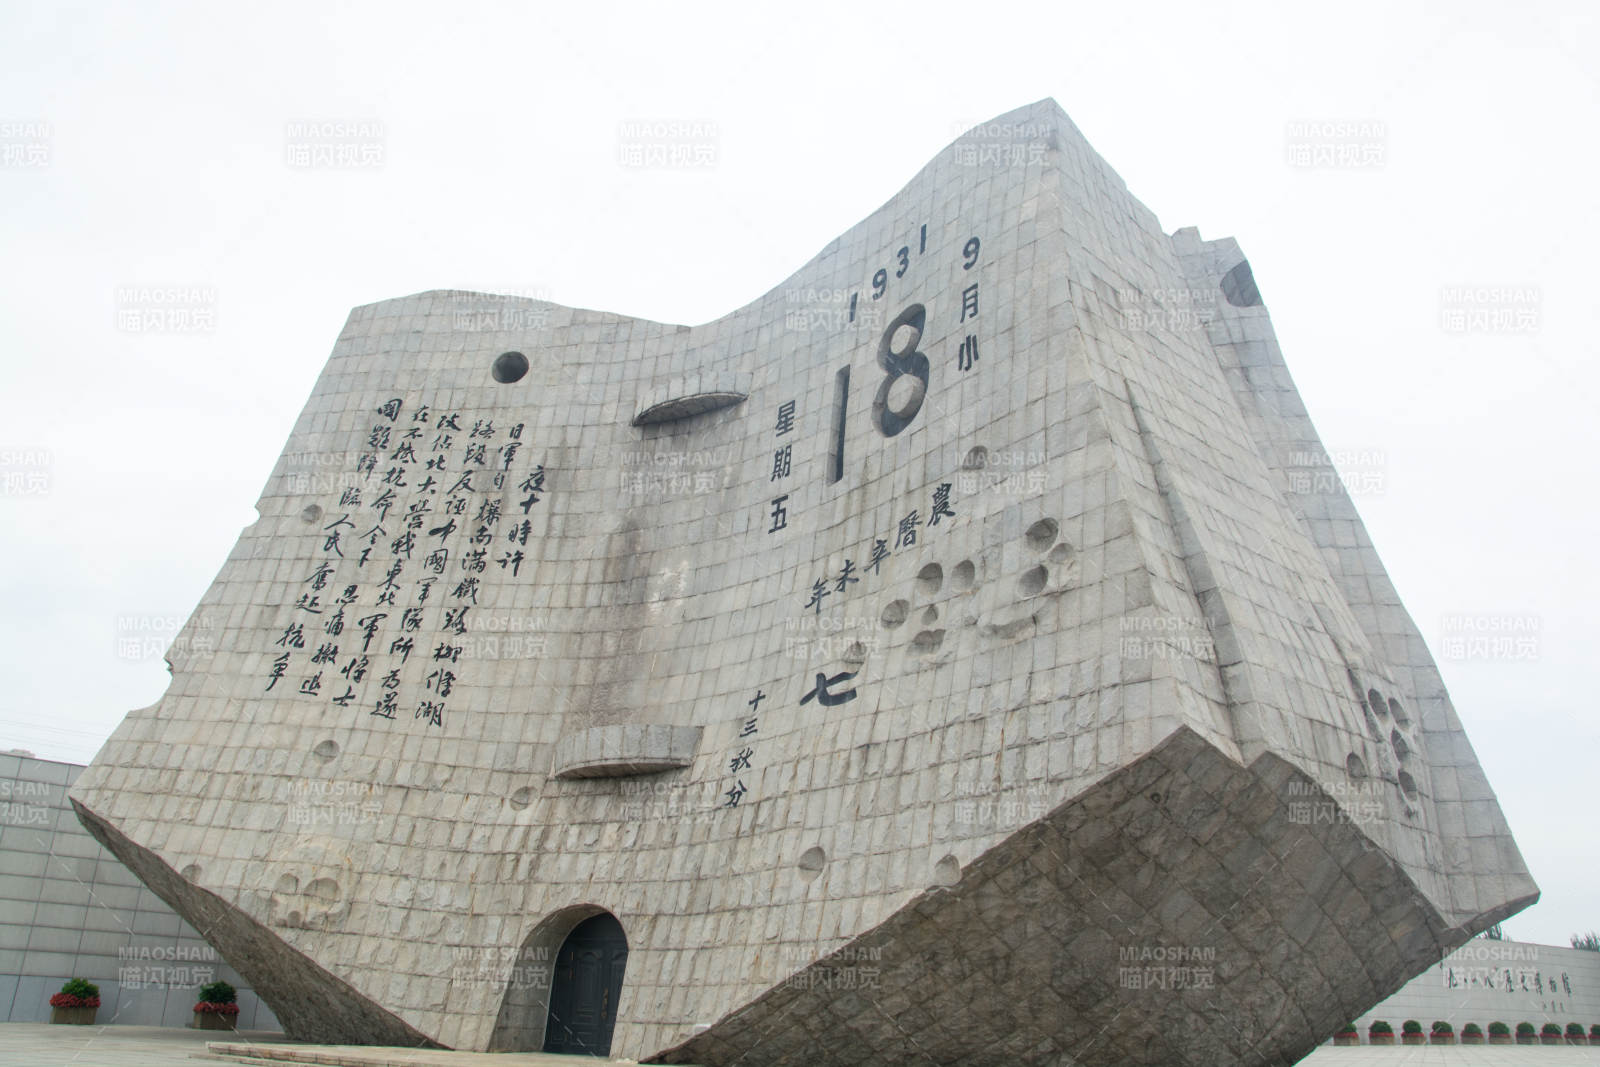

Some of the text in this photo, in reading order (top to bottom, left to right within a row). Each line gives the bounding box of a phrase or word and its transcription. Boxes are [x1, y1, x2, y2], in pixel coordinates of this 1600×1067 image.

[850, 223, 927, 323] 1931
[826, 303, 930, 486] 18
[768, 400, 796, 534] 星期五
[800, 671, 859, 707] 七
